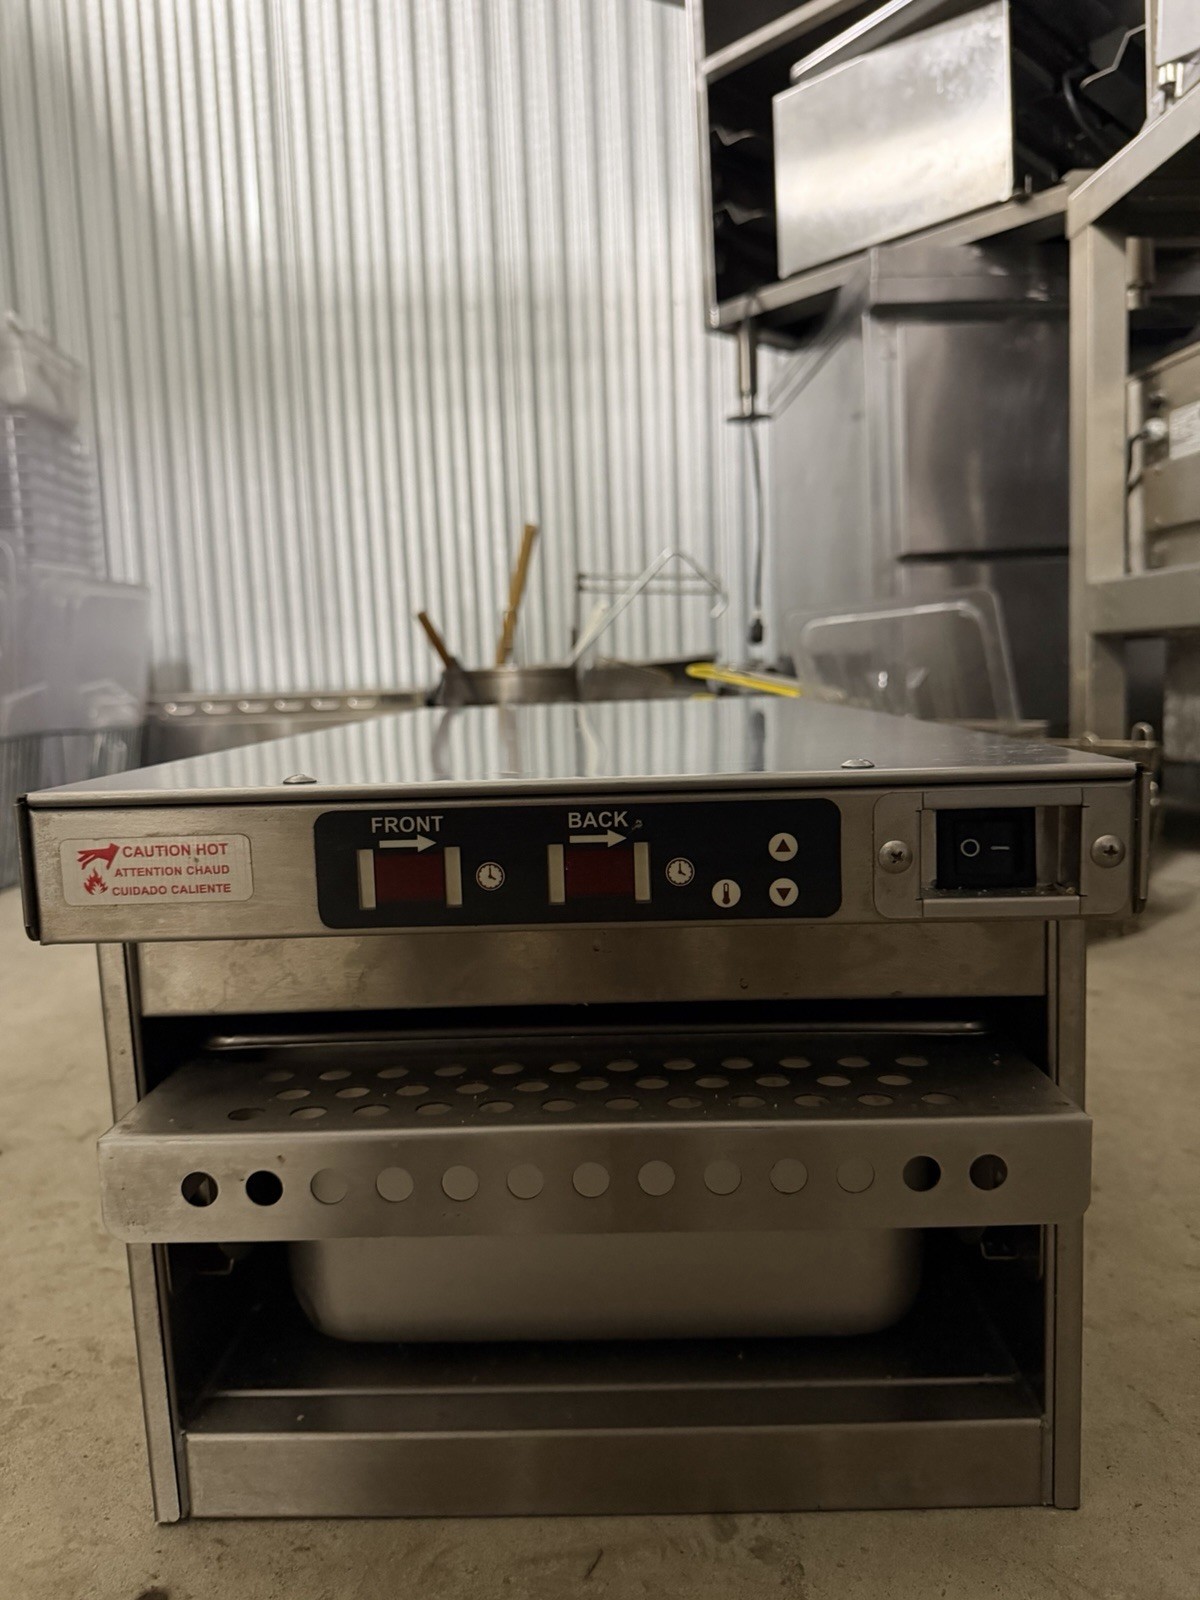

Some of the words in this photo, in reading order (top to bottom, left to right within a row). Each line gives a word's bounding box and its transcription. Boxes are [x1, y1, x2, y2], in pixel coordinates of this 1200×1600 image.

[371, 815, 443, 834] FRONT
[568, 811, 628, 829] BACK
[122, 844, 191, 858] CAUTION
[196, 843, 229, 856] HOT
[114, 866, 183, 877] ATTENTION
[187, 864, 230, 876] CHAUD
[112, 885, 167, 896] CUIDADO
[171, 883, 231, 895] CALIENTE
